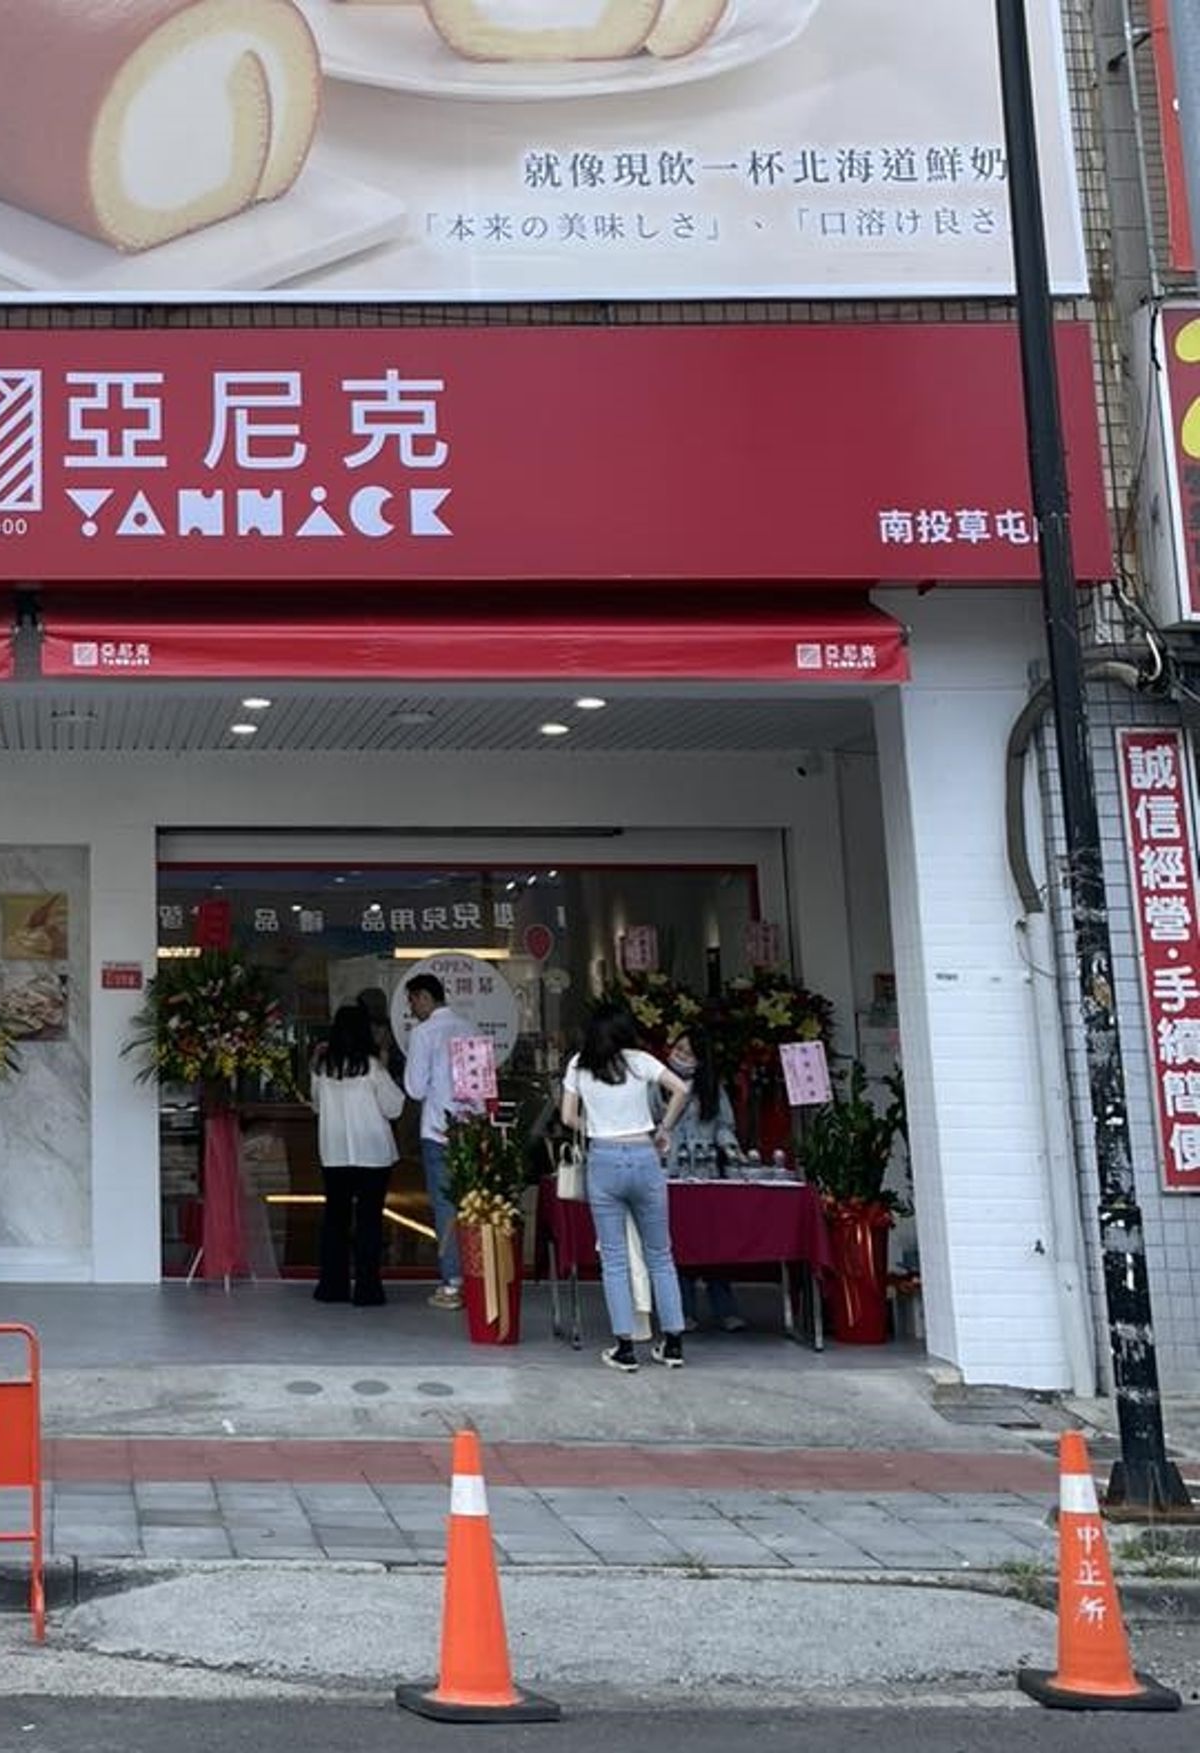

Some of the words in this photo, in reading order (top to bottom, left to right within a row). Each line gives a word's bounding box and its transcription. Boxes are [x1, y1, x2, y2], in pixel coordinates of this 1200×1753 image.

[64, 369, 448, 470] 亞尼克
[878, 509, 1040, 544] 南投草屯
